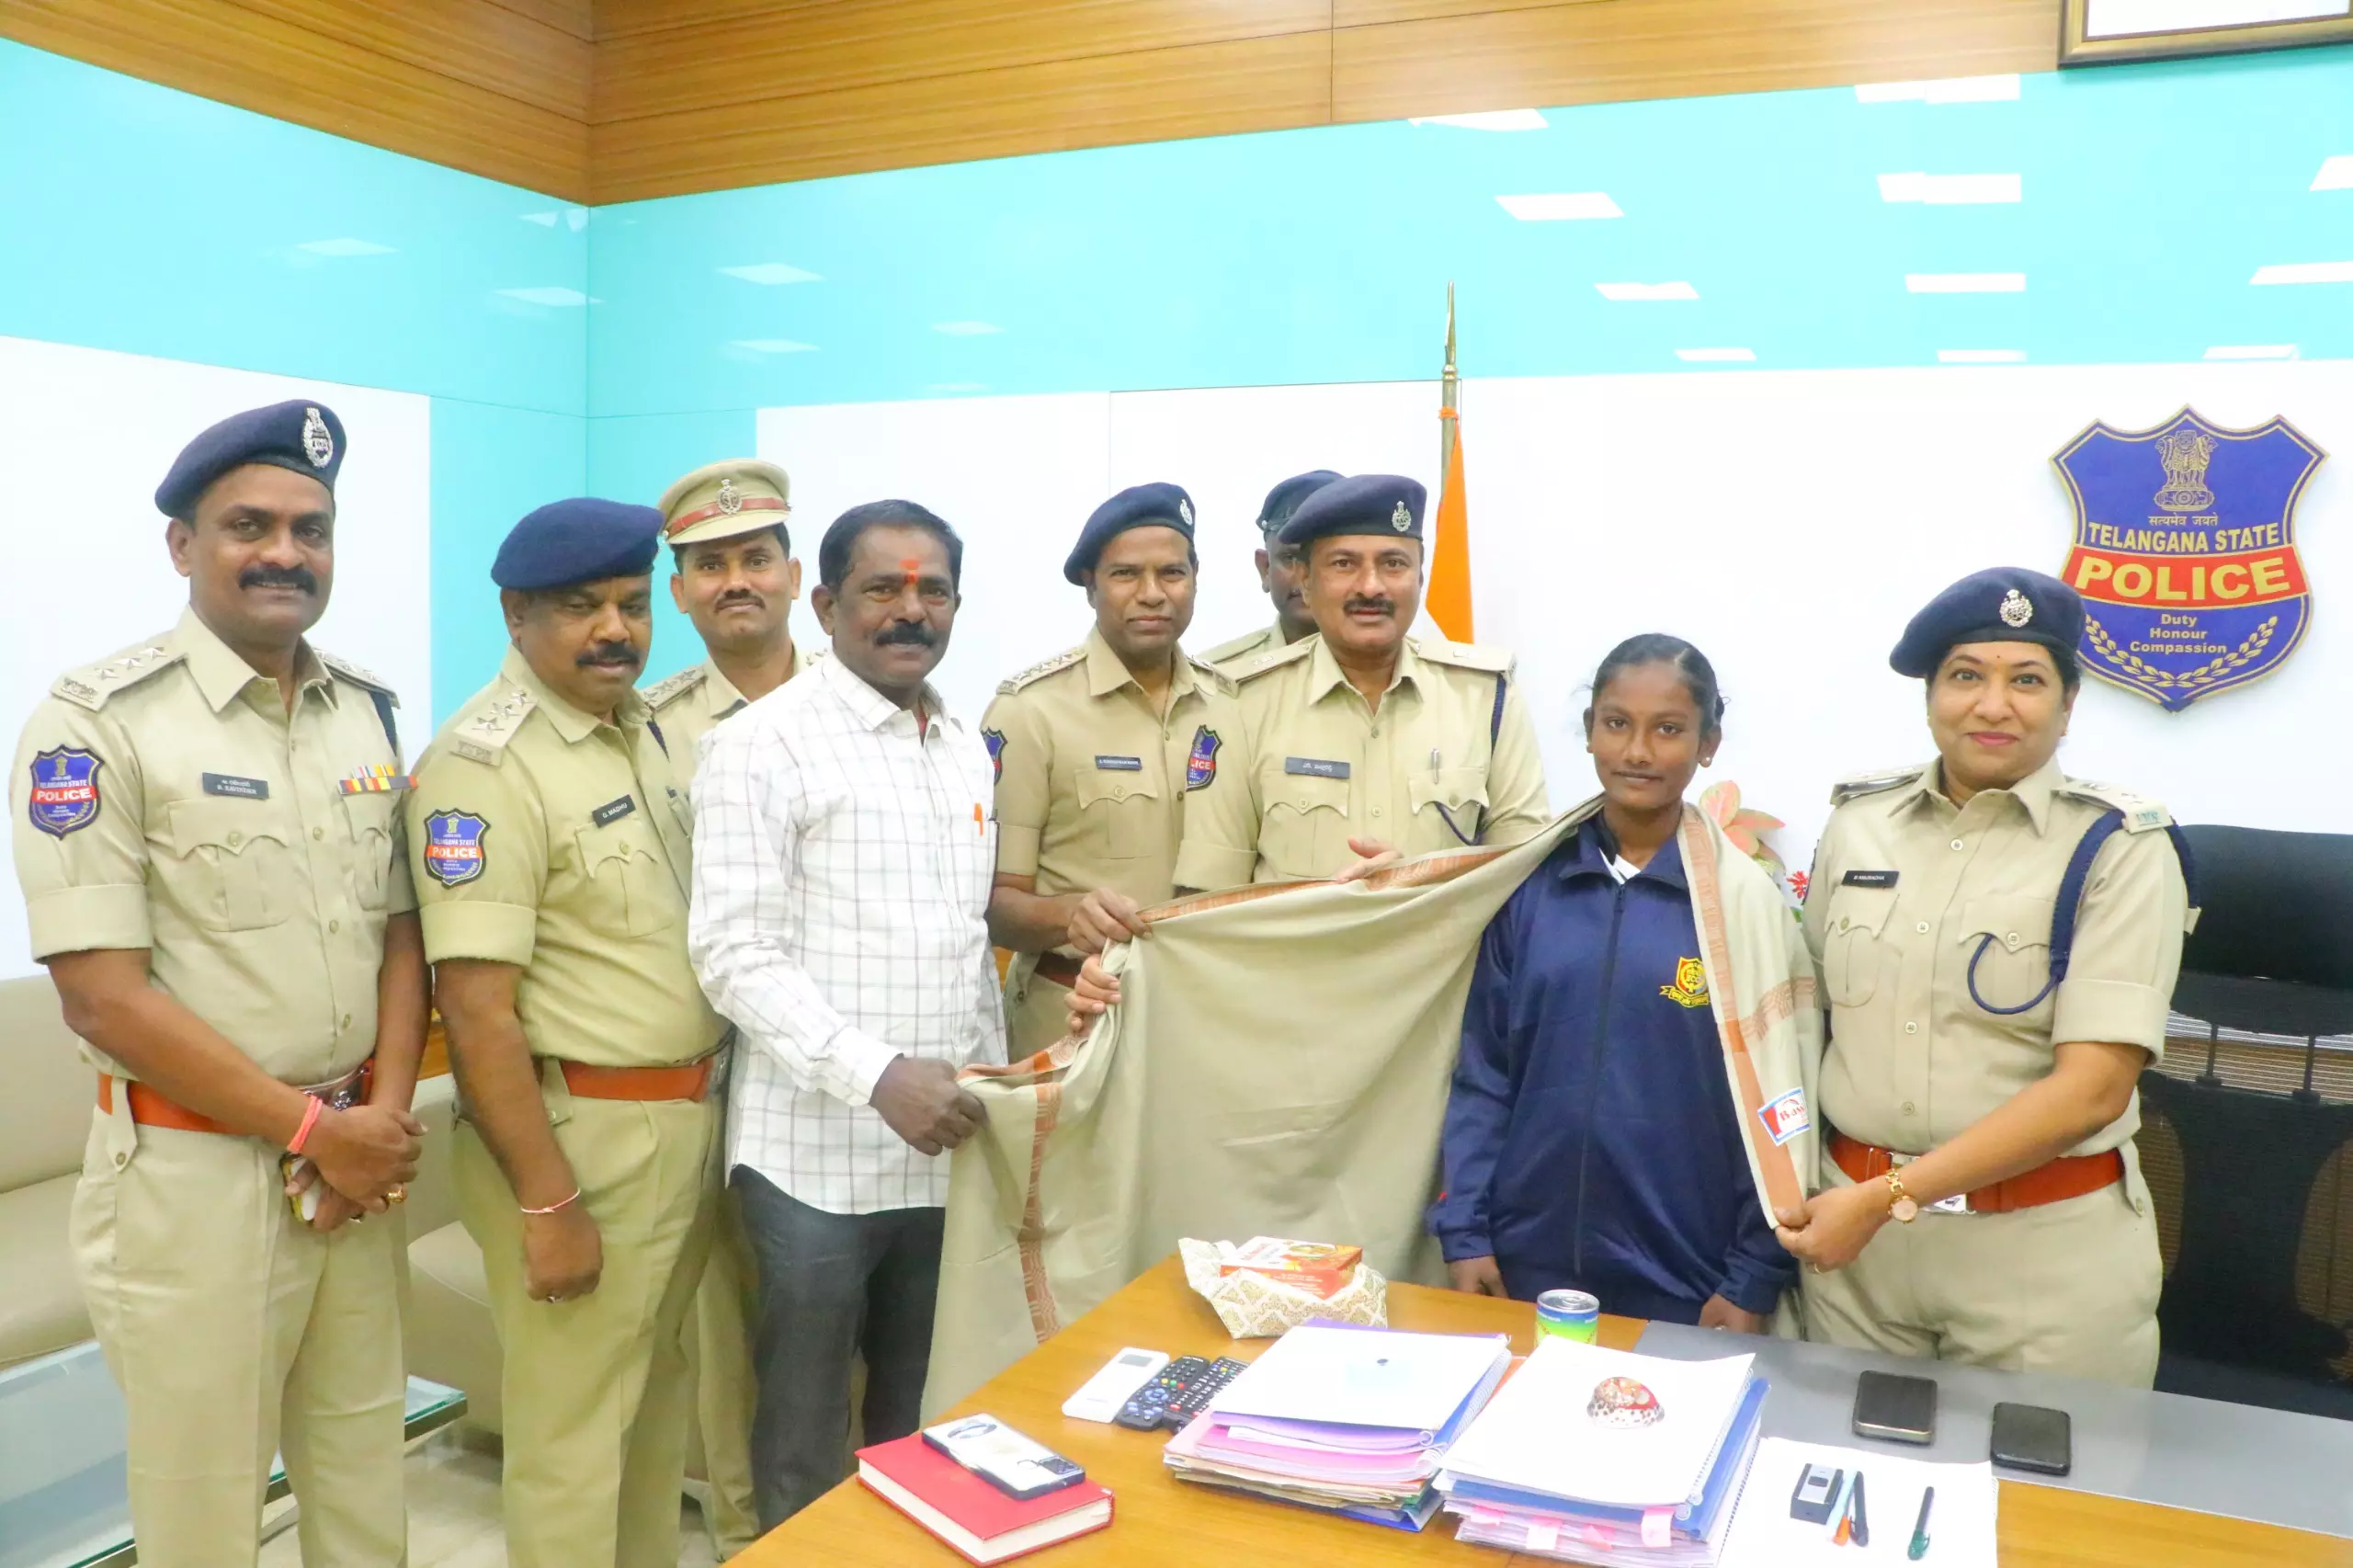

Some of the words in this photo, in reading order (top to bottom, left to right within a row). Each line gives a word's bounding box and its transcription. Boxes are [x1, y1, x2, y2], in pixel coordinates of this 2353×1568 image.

[2147, 511, 2187, 527] सत्यमेव
[2191, 511, 2218, 527] जयते
[2088, 522, 2209, 552] TELANGANA
[2215, 522, 2280, 551] STATE
[2074, 555, 2290, 600] POLICE
[2161, 614, 2198, 628] Duty
[2150, 628, 2208, 640] Honour
[2130, 642, 2227, 654] Compassion
[37, 788, 92, 801] POLICE
[608, 802, 628, 815] MADHU
[433, 846, 477, 858] POLICE
